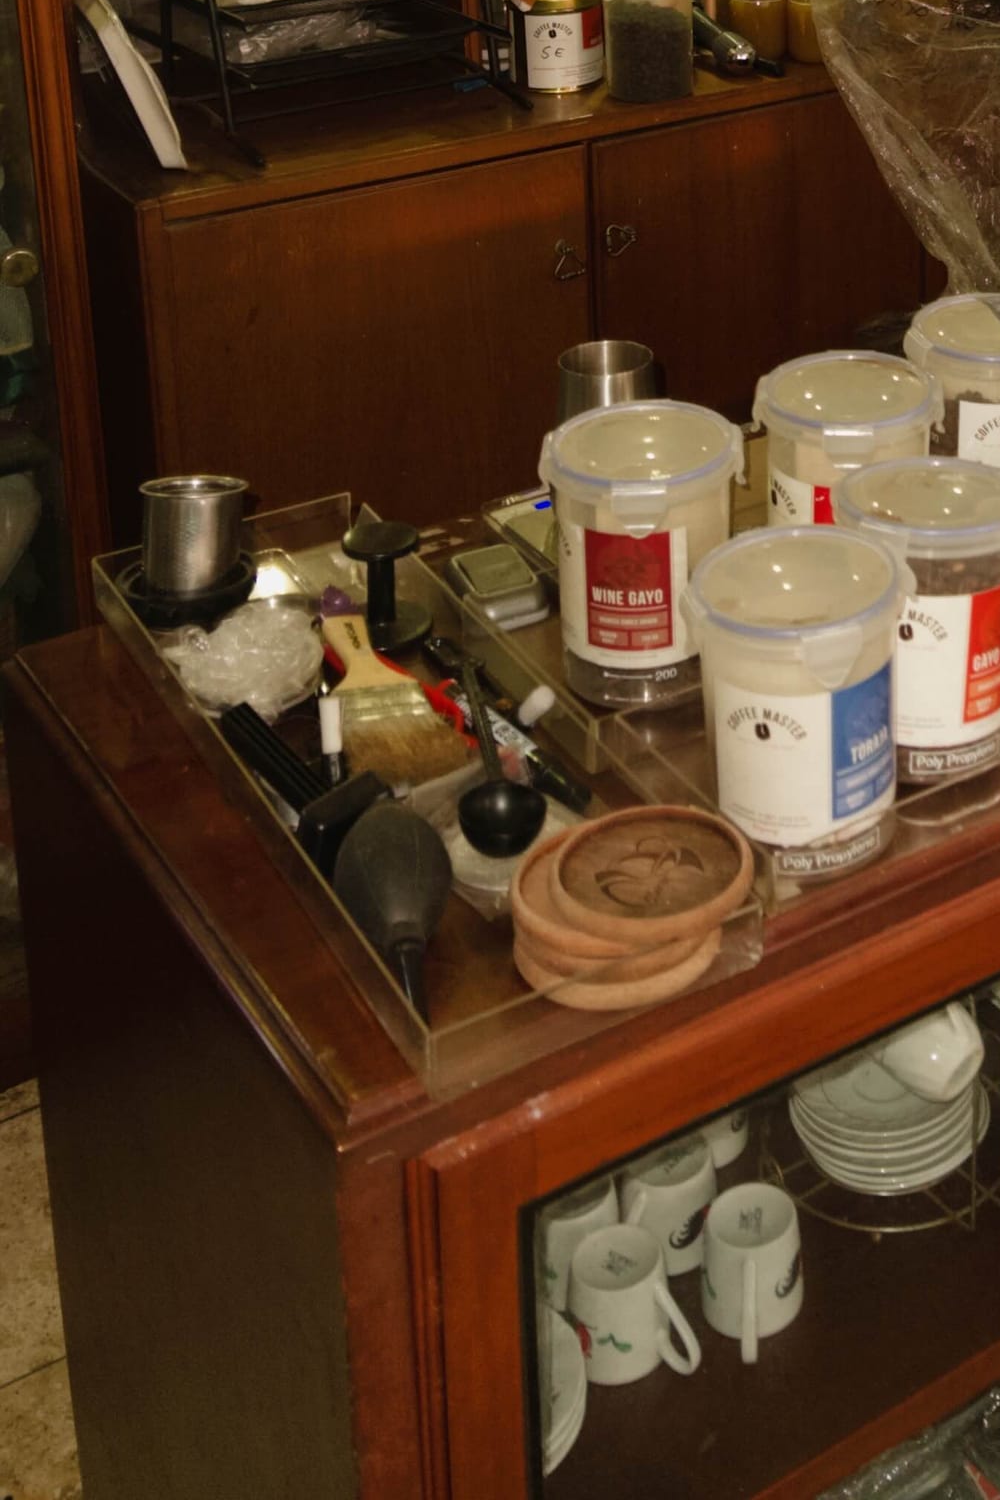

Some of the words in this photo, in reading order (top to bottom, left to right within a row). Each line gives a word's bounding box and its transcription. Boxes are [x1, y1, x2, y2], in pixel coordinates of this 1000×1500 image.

[592, 586, 623, 605] WINE
[629, 588, 664, 606] GAYO
[908, 609, 948, 642] MASTER
[973, 647, 1000, 673] GAYO
[655, 668, 678, 682] 200
[727, 706, 758, 731] COFFEE
[762, 707, 808, 741] MASTER
[917, 755, 944, 771] Poly
[783, 856, 814, 870] Poly
[816, 836, 876, 868] Propylene
